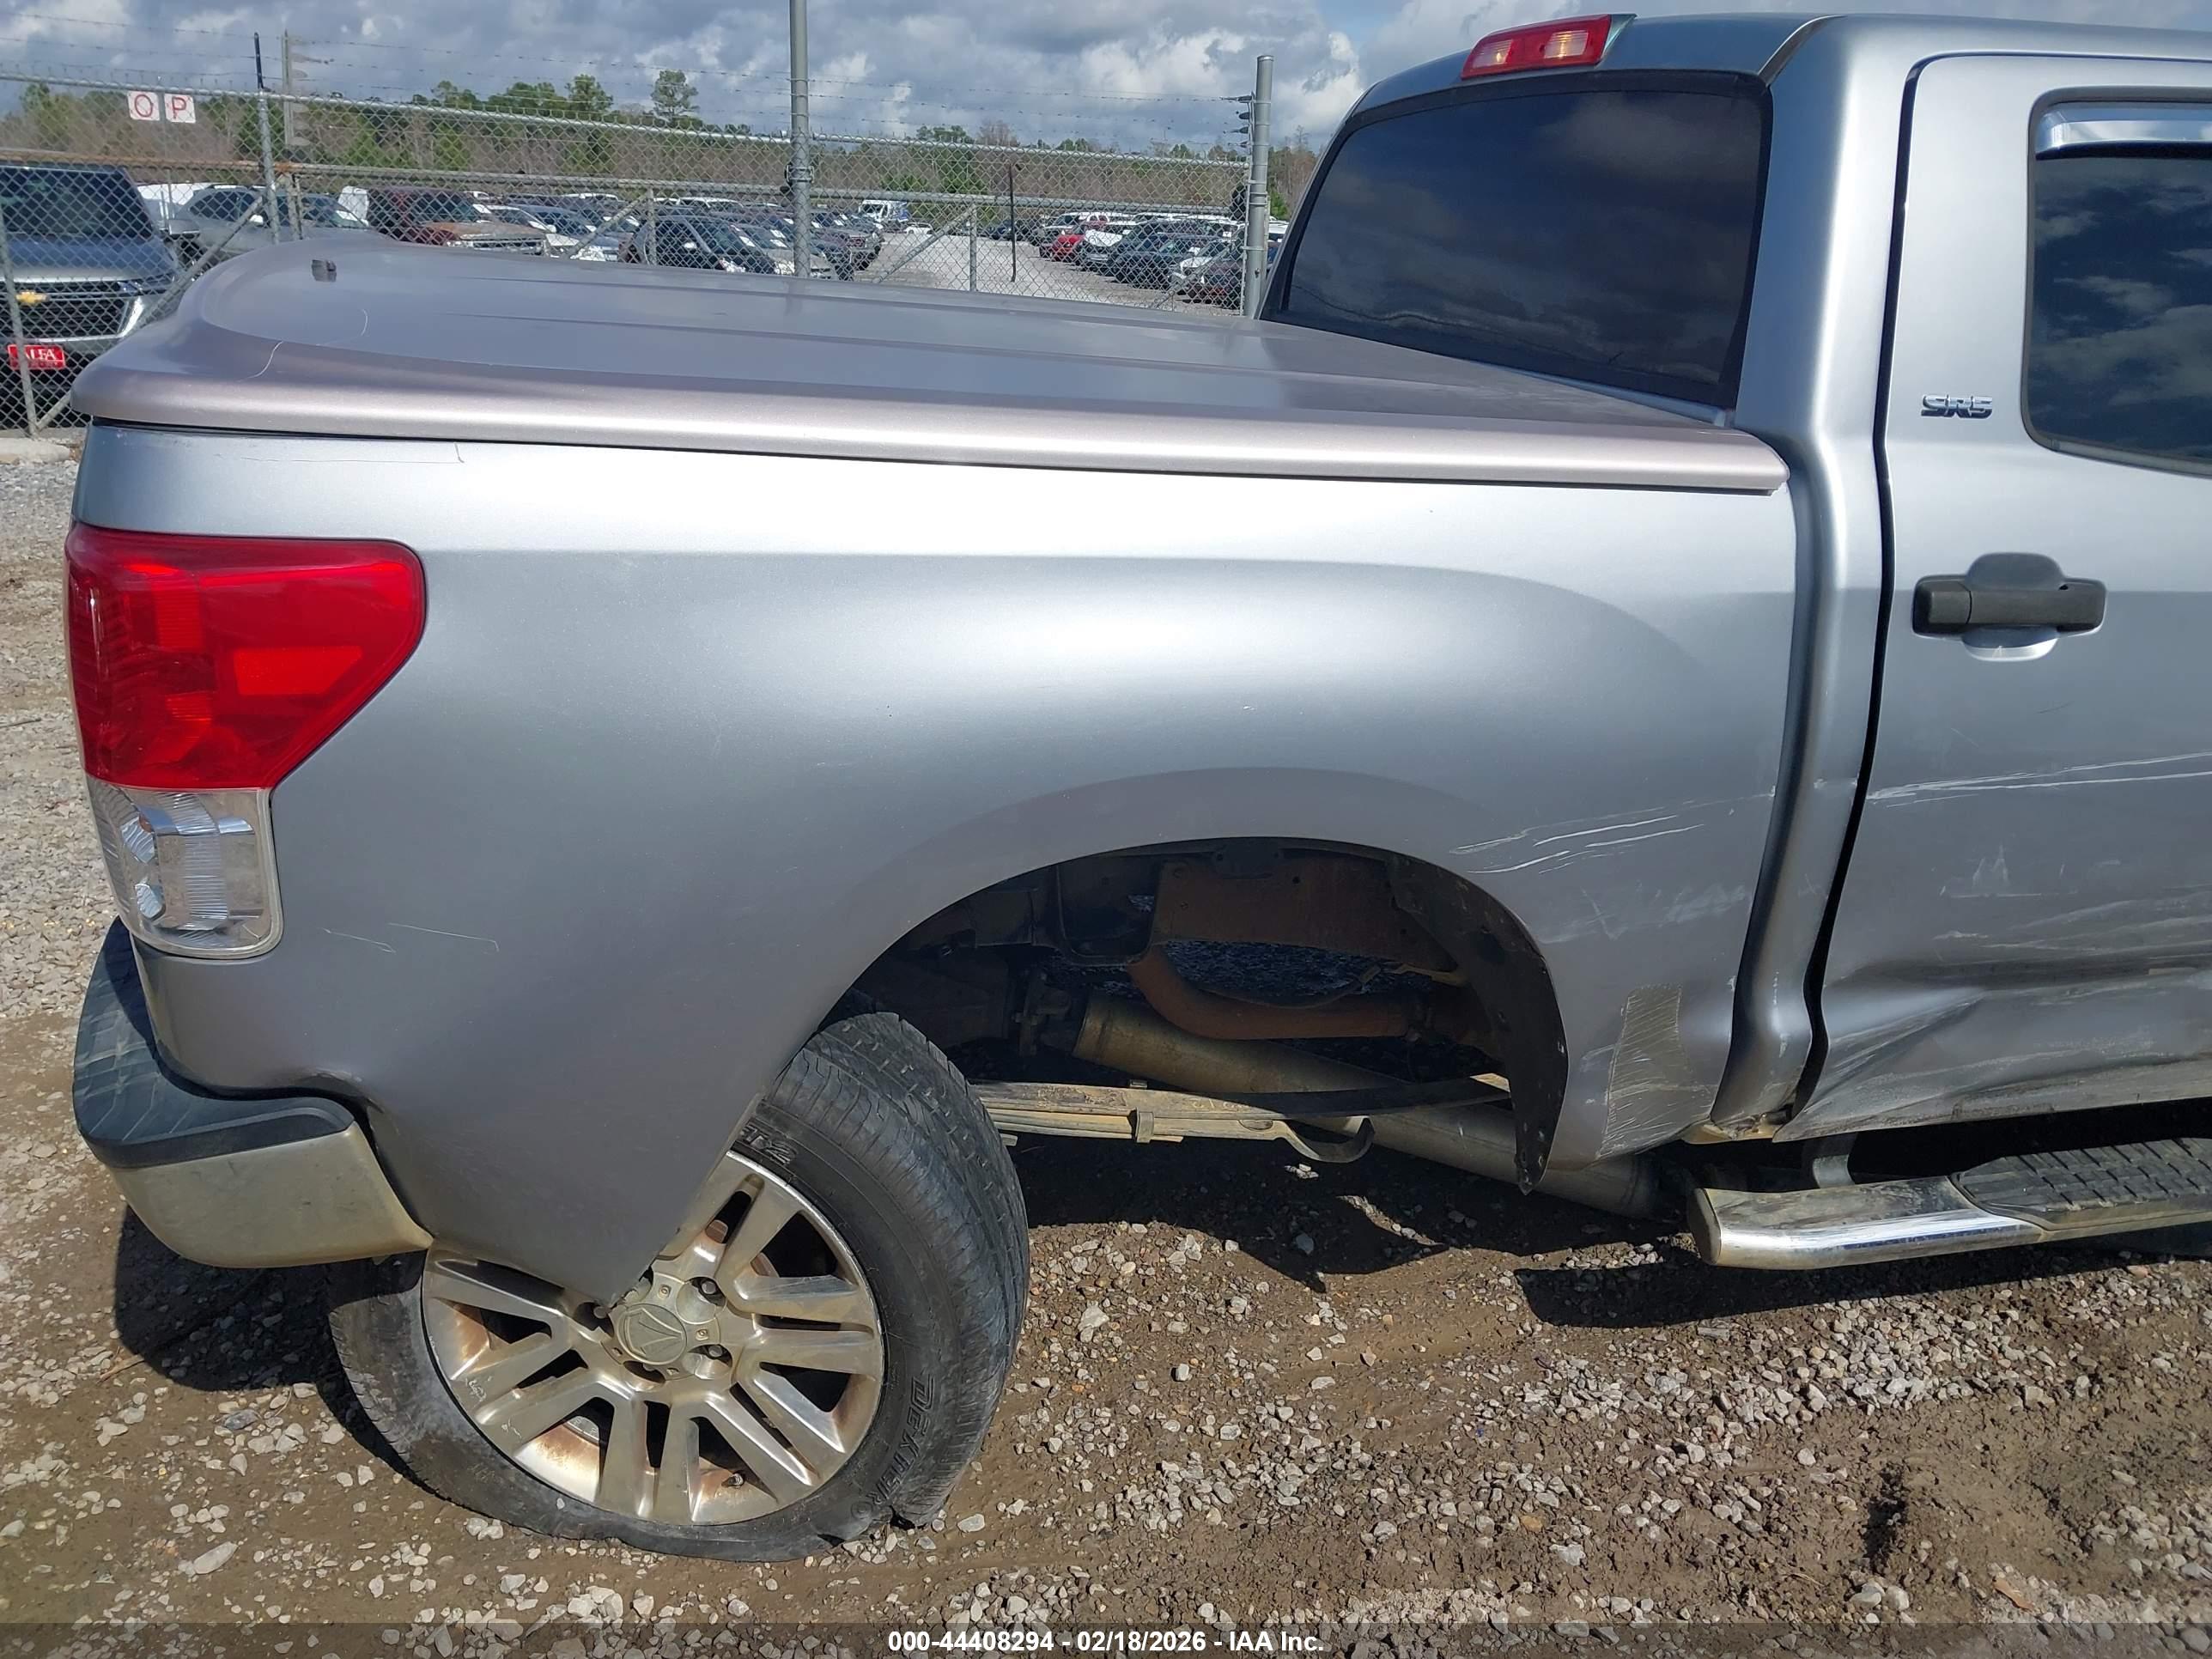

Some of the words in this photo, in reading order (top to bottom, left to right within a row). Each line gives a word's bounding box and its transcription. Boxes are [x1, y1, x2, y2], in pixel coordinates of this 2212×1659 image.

[171, 95, 187, 120] P
[25, 349, 57, 360] LFA
[1922, 394, 1993, 419] SR5
